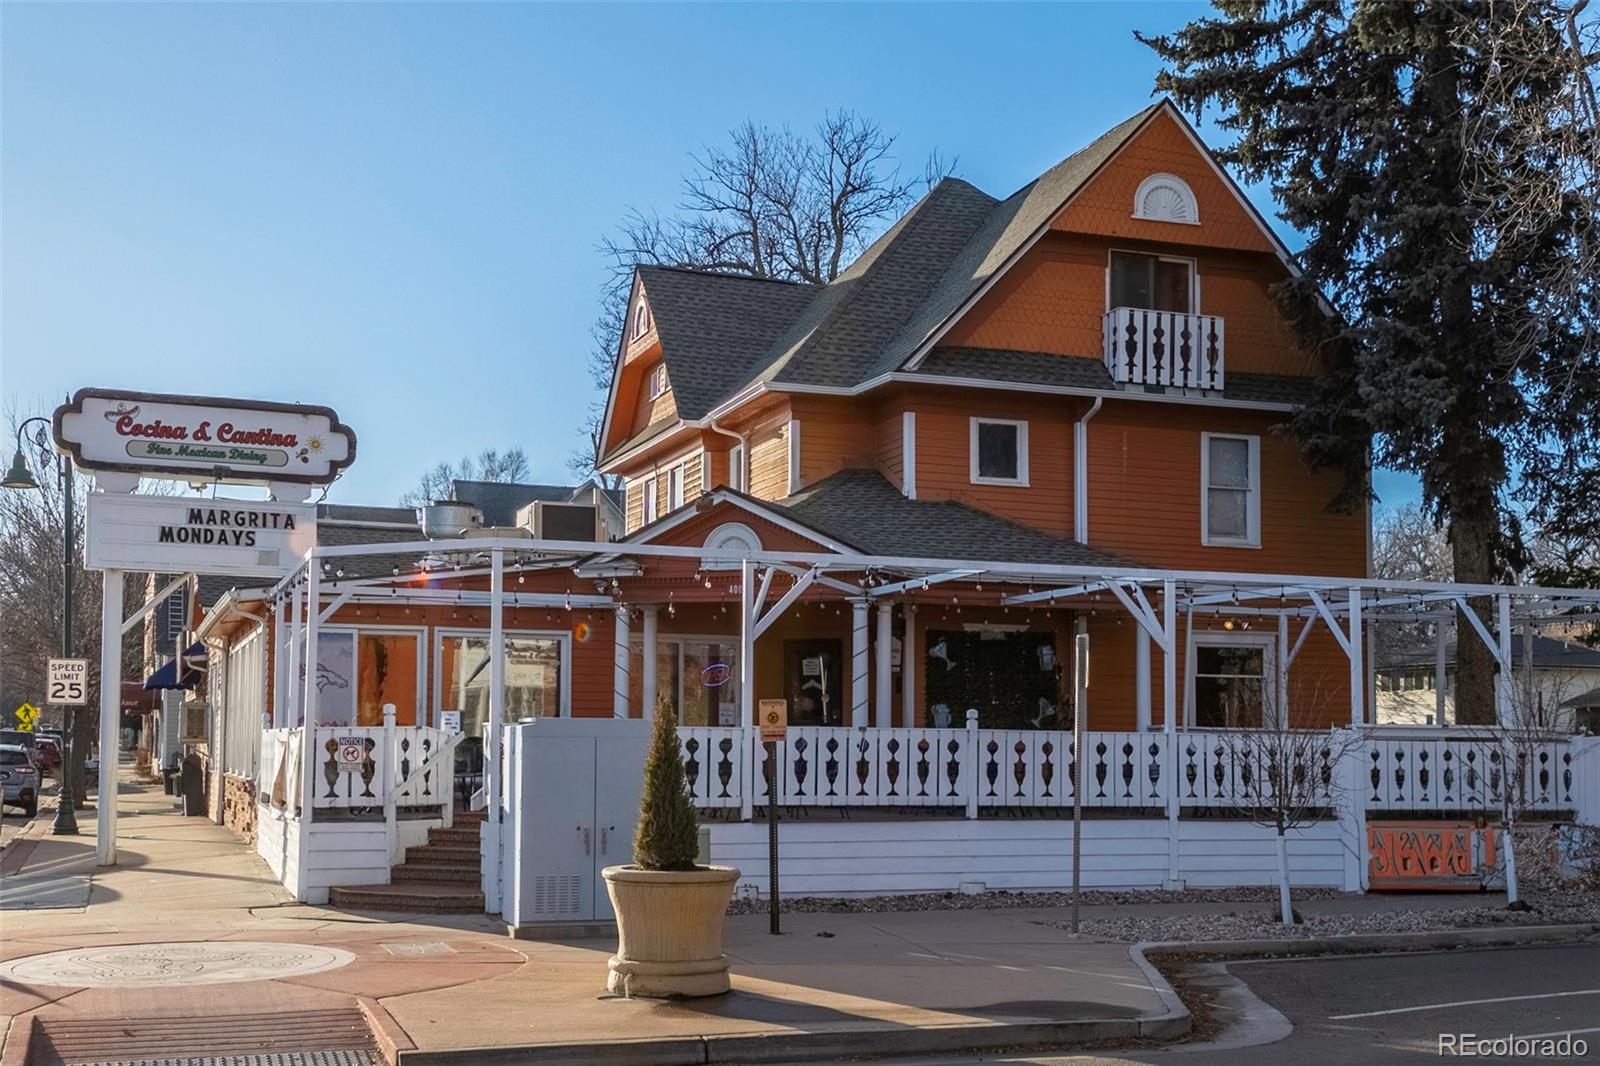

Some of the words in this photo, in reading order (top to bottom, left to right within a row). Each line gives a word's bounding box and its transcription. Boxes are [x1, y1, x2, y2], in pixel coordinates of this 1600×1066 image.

[116, 415, 188, 439] Cocina
[192, 421, 212, 441] &
[217, 423, 298, 447] Cantina
[147, 443, 173, 455] Fine
[175, 444, 226, 459] Mexican
[229, 449, 267, 464] Dining
[188, 508, 295, 529] MARGRITA
[160, 526, 255, 546] MONDAYS
[51, 663, 84, 671] SPEED
[51, 682, 82, 699] 25
[340, 737, 363, 746] NOTICE
